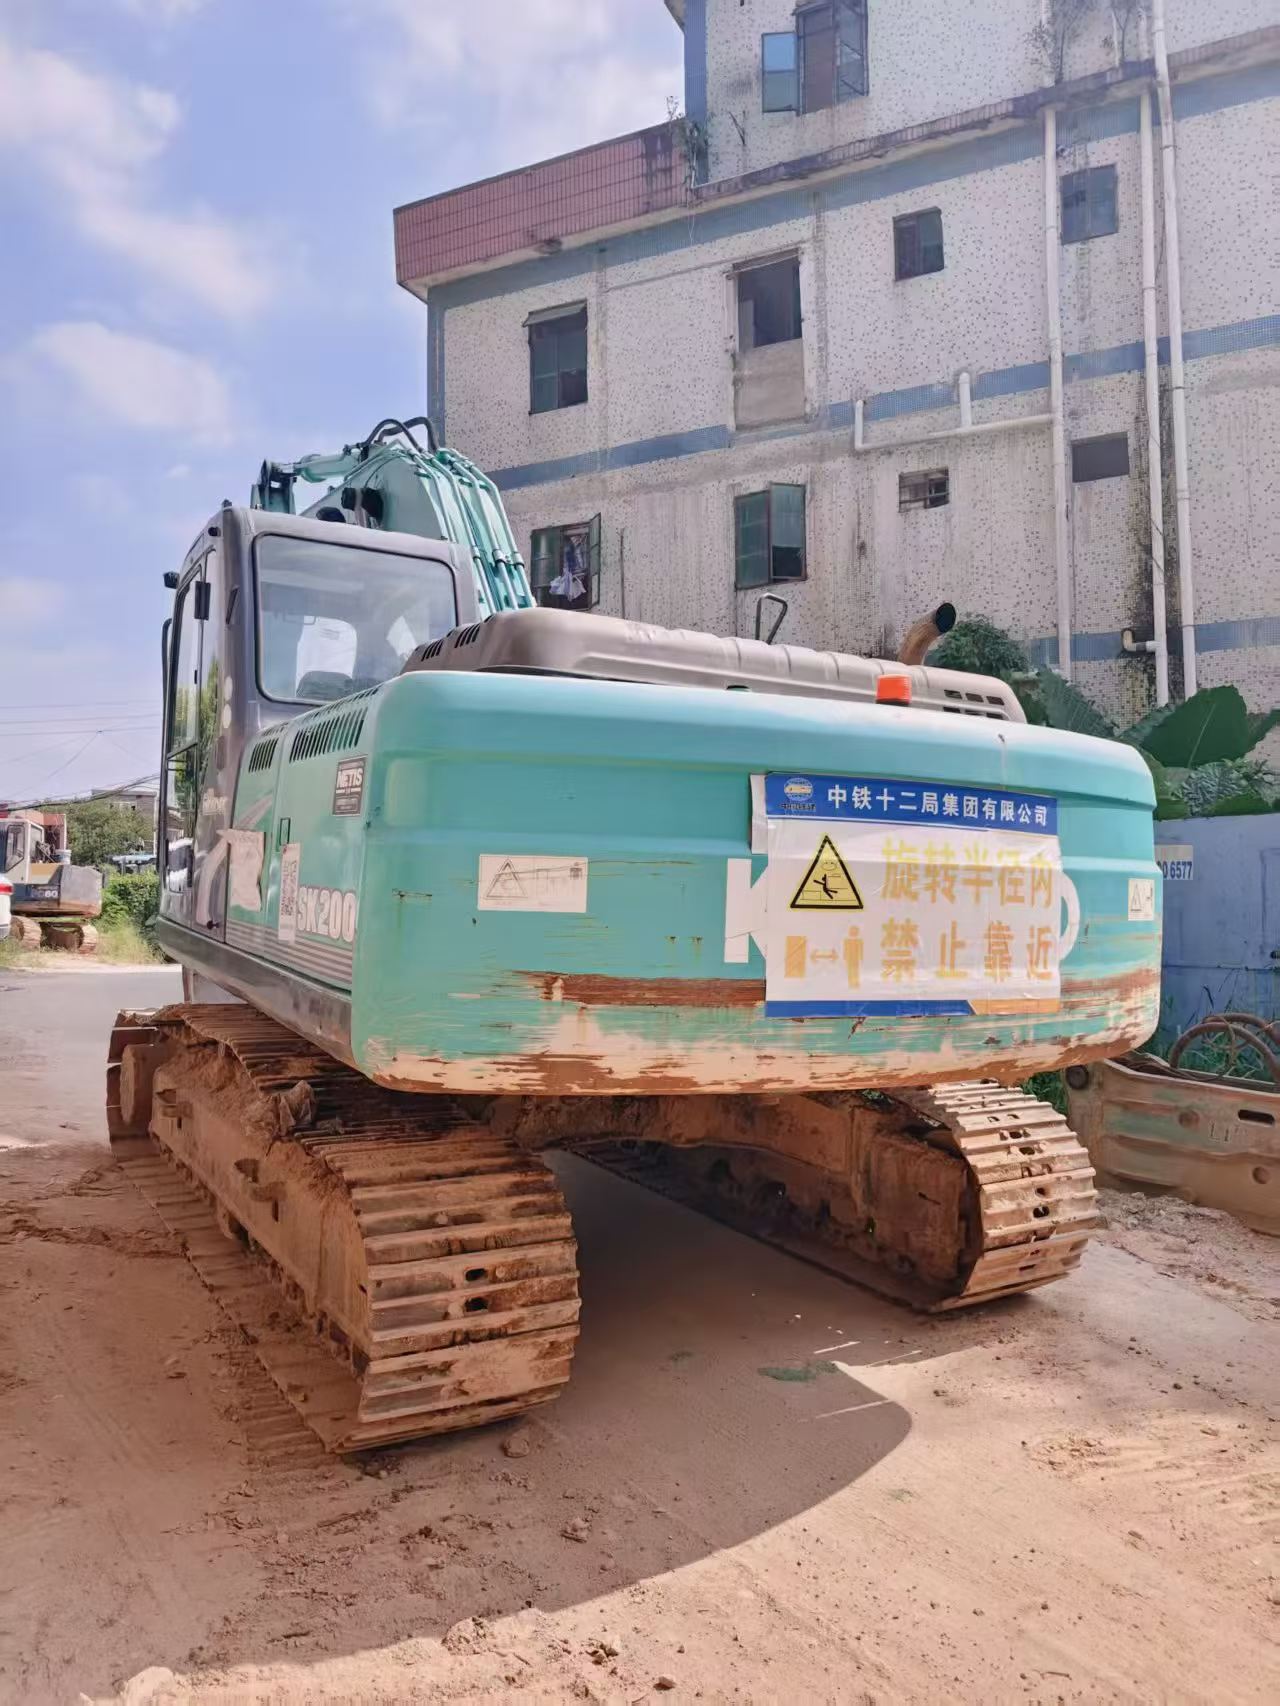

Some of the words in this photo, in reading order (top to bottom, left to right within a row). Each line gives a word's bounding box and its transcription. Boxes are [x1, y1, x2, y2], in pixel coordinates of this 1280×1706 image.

[336, 767, 364, 789] NETIS
[827, 784, 1048, 826] 中铁十二局集团有限公司
[880, 836, 1054, 909] 旋转半径内
[296, 886, 356, 943] SK200
[880, 917, 1055, 982] 禁止靠近
